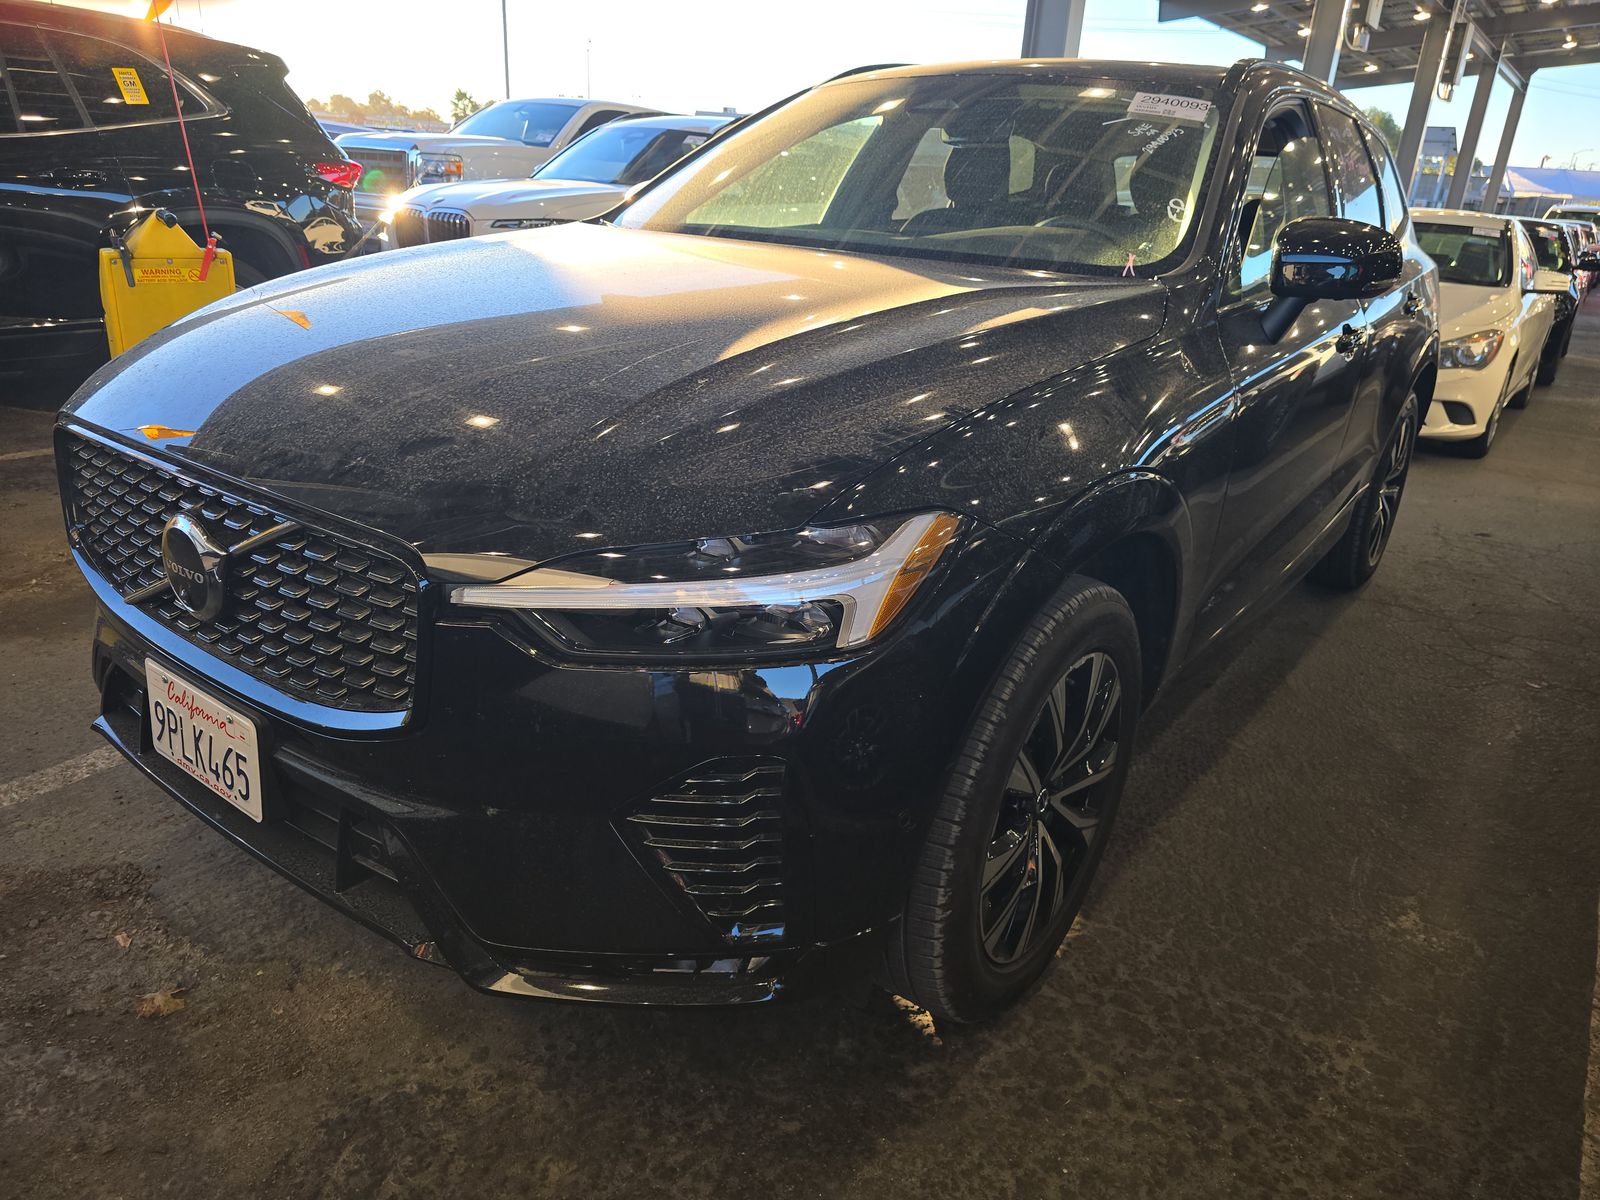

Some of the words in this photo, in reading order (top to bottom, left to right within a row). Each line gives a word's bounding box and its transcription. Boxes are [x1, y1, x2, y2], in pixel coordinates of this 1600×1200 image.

[1140, 96, 1209, 111] 2940093
[166, 560, 204, 584] VOLVO
[167, 681, 235, 739] California
[154, 700, 250, 801] 9PLK465
